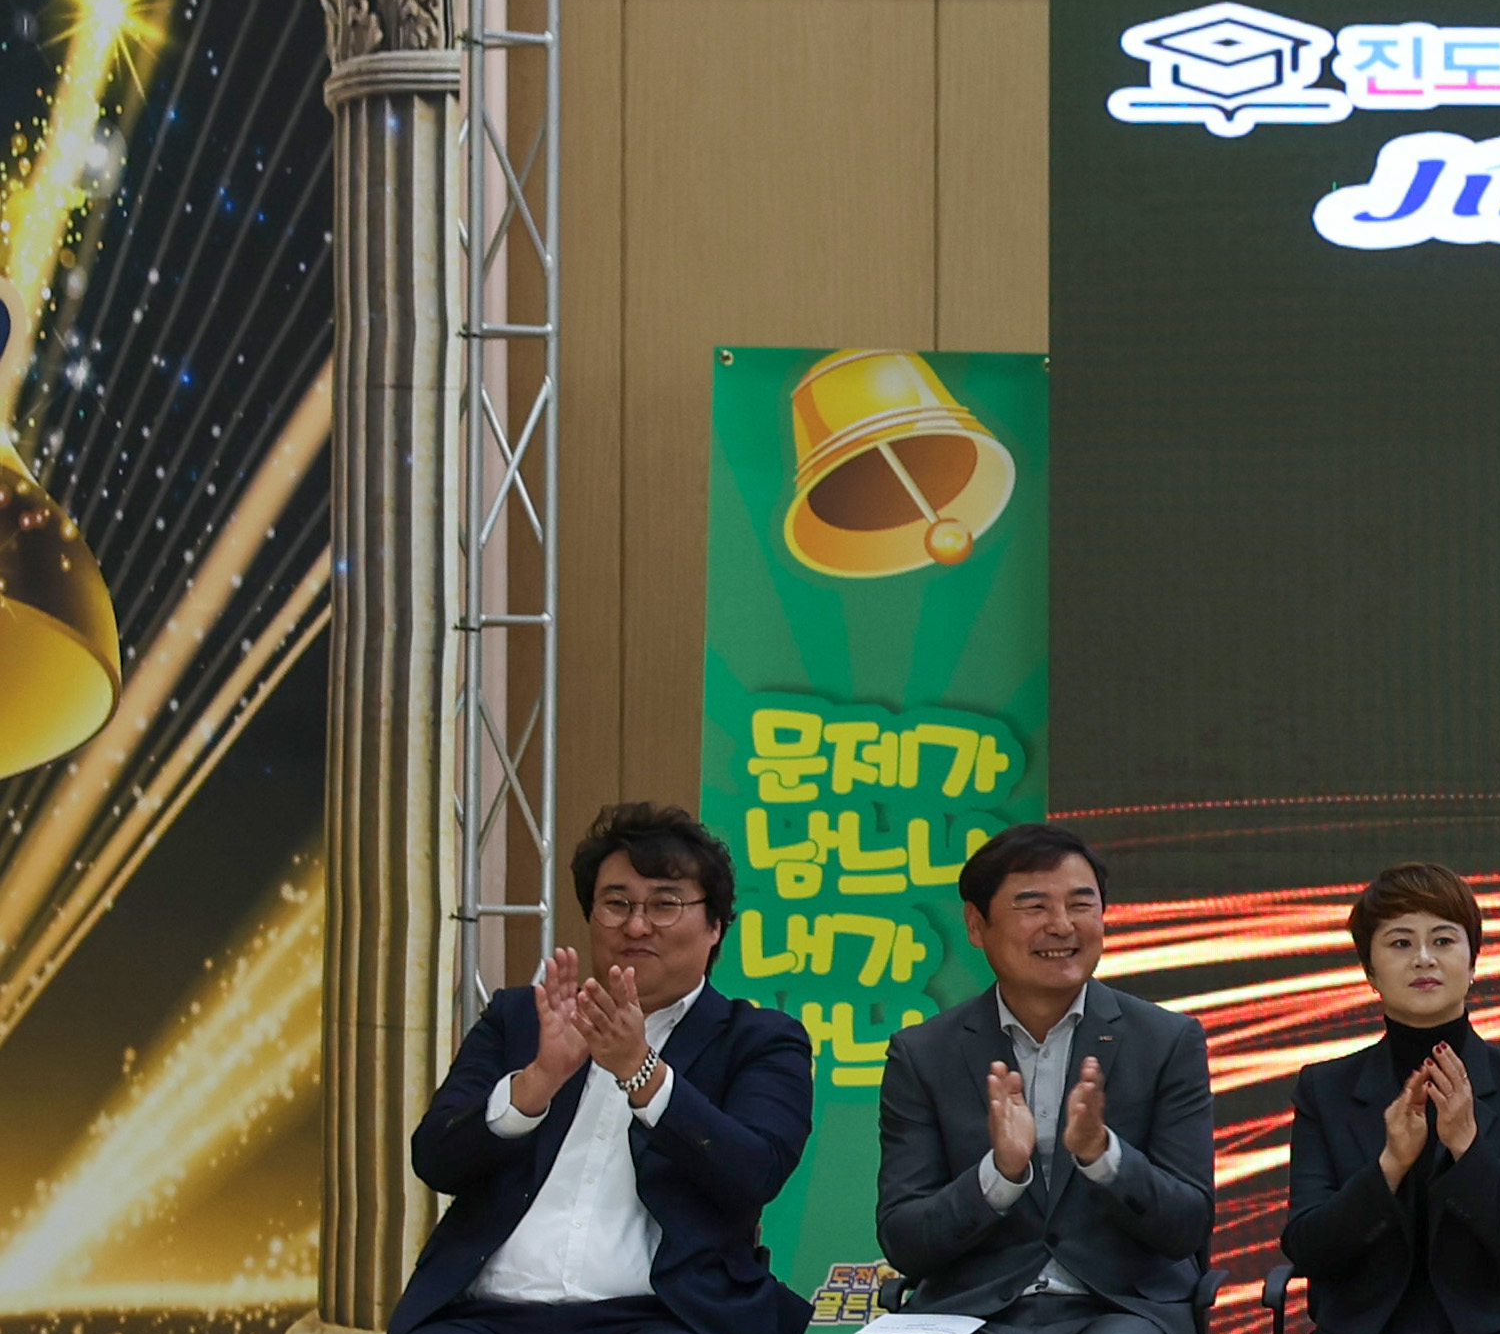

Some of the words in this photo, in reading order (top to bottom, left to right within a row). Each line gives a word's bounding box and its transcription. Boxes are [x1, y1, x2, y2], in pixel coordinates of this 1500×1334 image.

[747, 708, 1009, 803] 문제가
[740, 909, 927, 987] 내가
[828, 1265, 876, 1292] 도전
